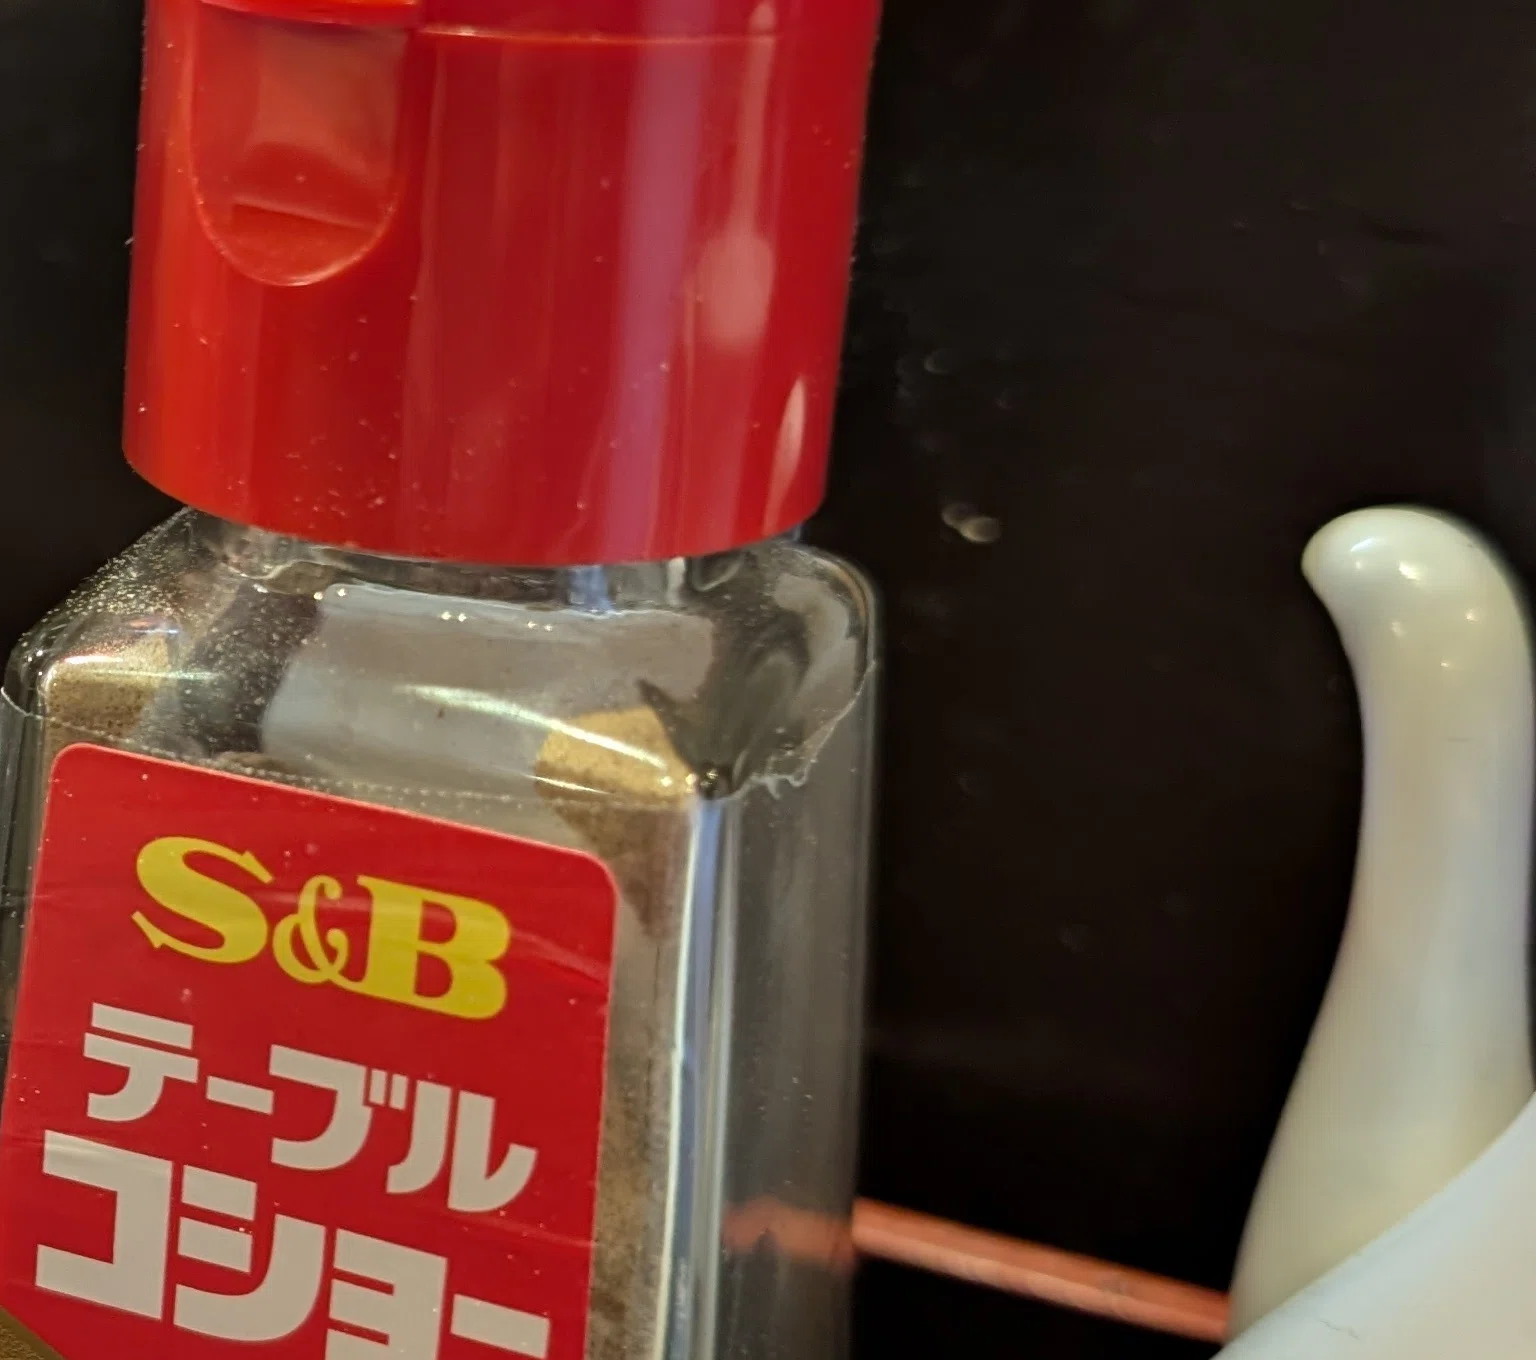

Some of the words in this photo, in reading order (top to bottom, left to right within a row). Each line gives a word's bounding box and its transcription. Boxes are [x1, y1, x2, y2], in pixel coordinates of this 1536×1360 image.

[131, 835, 511, 1020] S&B
[83, 1001, 539, 1213] テーブル
